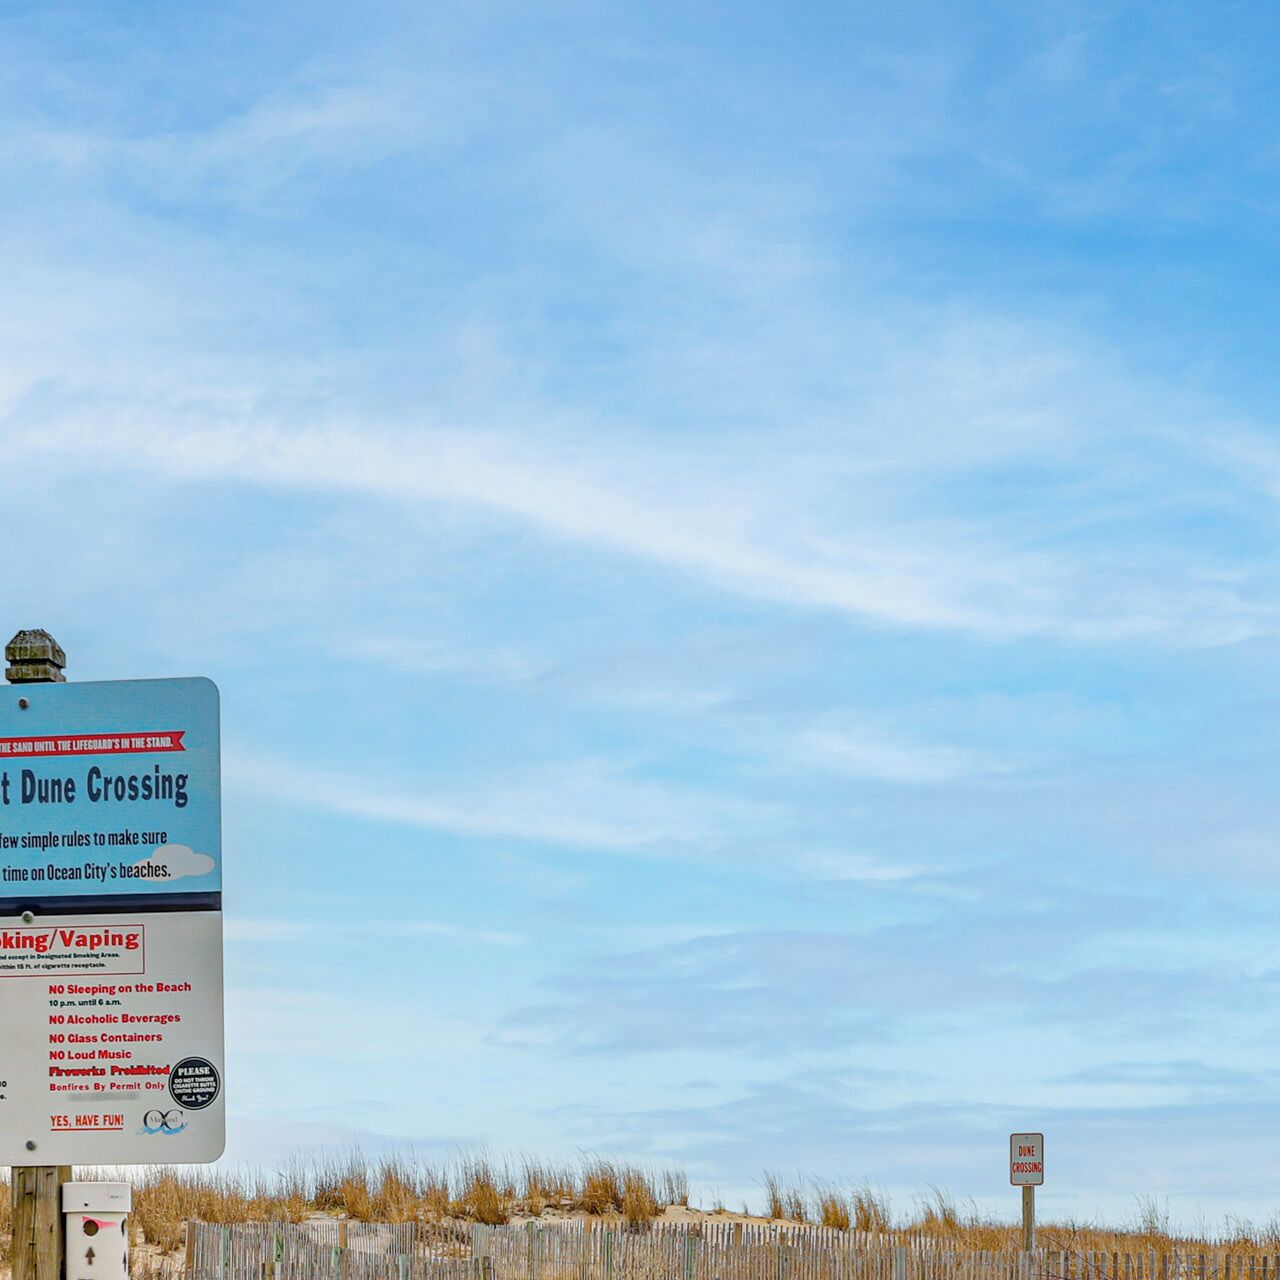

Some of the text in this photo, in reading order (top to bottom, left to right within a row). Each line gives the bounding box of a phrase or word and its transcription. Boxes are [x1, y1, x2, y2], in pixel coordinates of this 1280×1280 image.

[12, 742, 32, 753] SAND
[34, 741, 56, 752] UNTIL
[58, 740, 71, 752] THE
[73, 739, 120, 750] LIFEGUARD'S
[120, 738, 130, 750] IN
[130, 738, 145, 749] THE
[146, 737, 174, 748] STAND.
[21, 768, 76, 804] Dune
[87, 764, 188, 808] Crossing
[21, 832, 60, 852] simple
[62, 830, 90, 848] rules
[94, 832, 105, 846] to
[108, 829, 139, 846] make
[142, 832, 168, 844] sure
[2, 866, 28, 882] time
[31, 868, 44, 880] on
[47, 864, 82, 880] Ocean
[84, 862, 118, 883] City's
[120, 861, 172, 878] beaches.
[49, 982, 192, 996] NO Sleeping on the Beach
[49, 1014, 181, 1024] NO Alcoholic Beverages
[49, 1033, 163, 1043] NO Glass Containers
[49, 1050, 132, 1060] NO Loud Music
[49, 1065, 170, 1076] Fireworks Prohibited
[178, 1067, 210, 1076] PLEASE
[50, 1082, 165, 1092] Bonfires By Permit Only
[51, 1114, 124, 1128] YES, HAVE FUN!
[1019, 1146, 1034, 1157] DUNE
[1013, 1162, 1041, 1173] CROSSING
